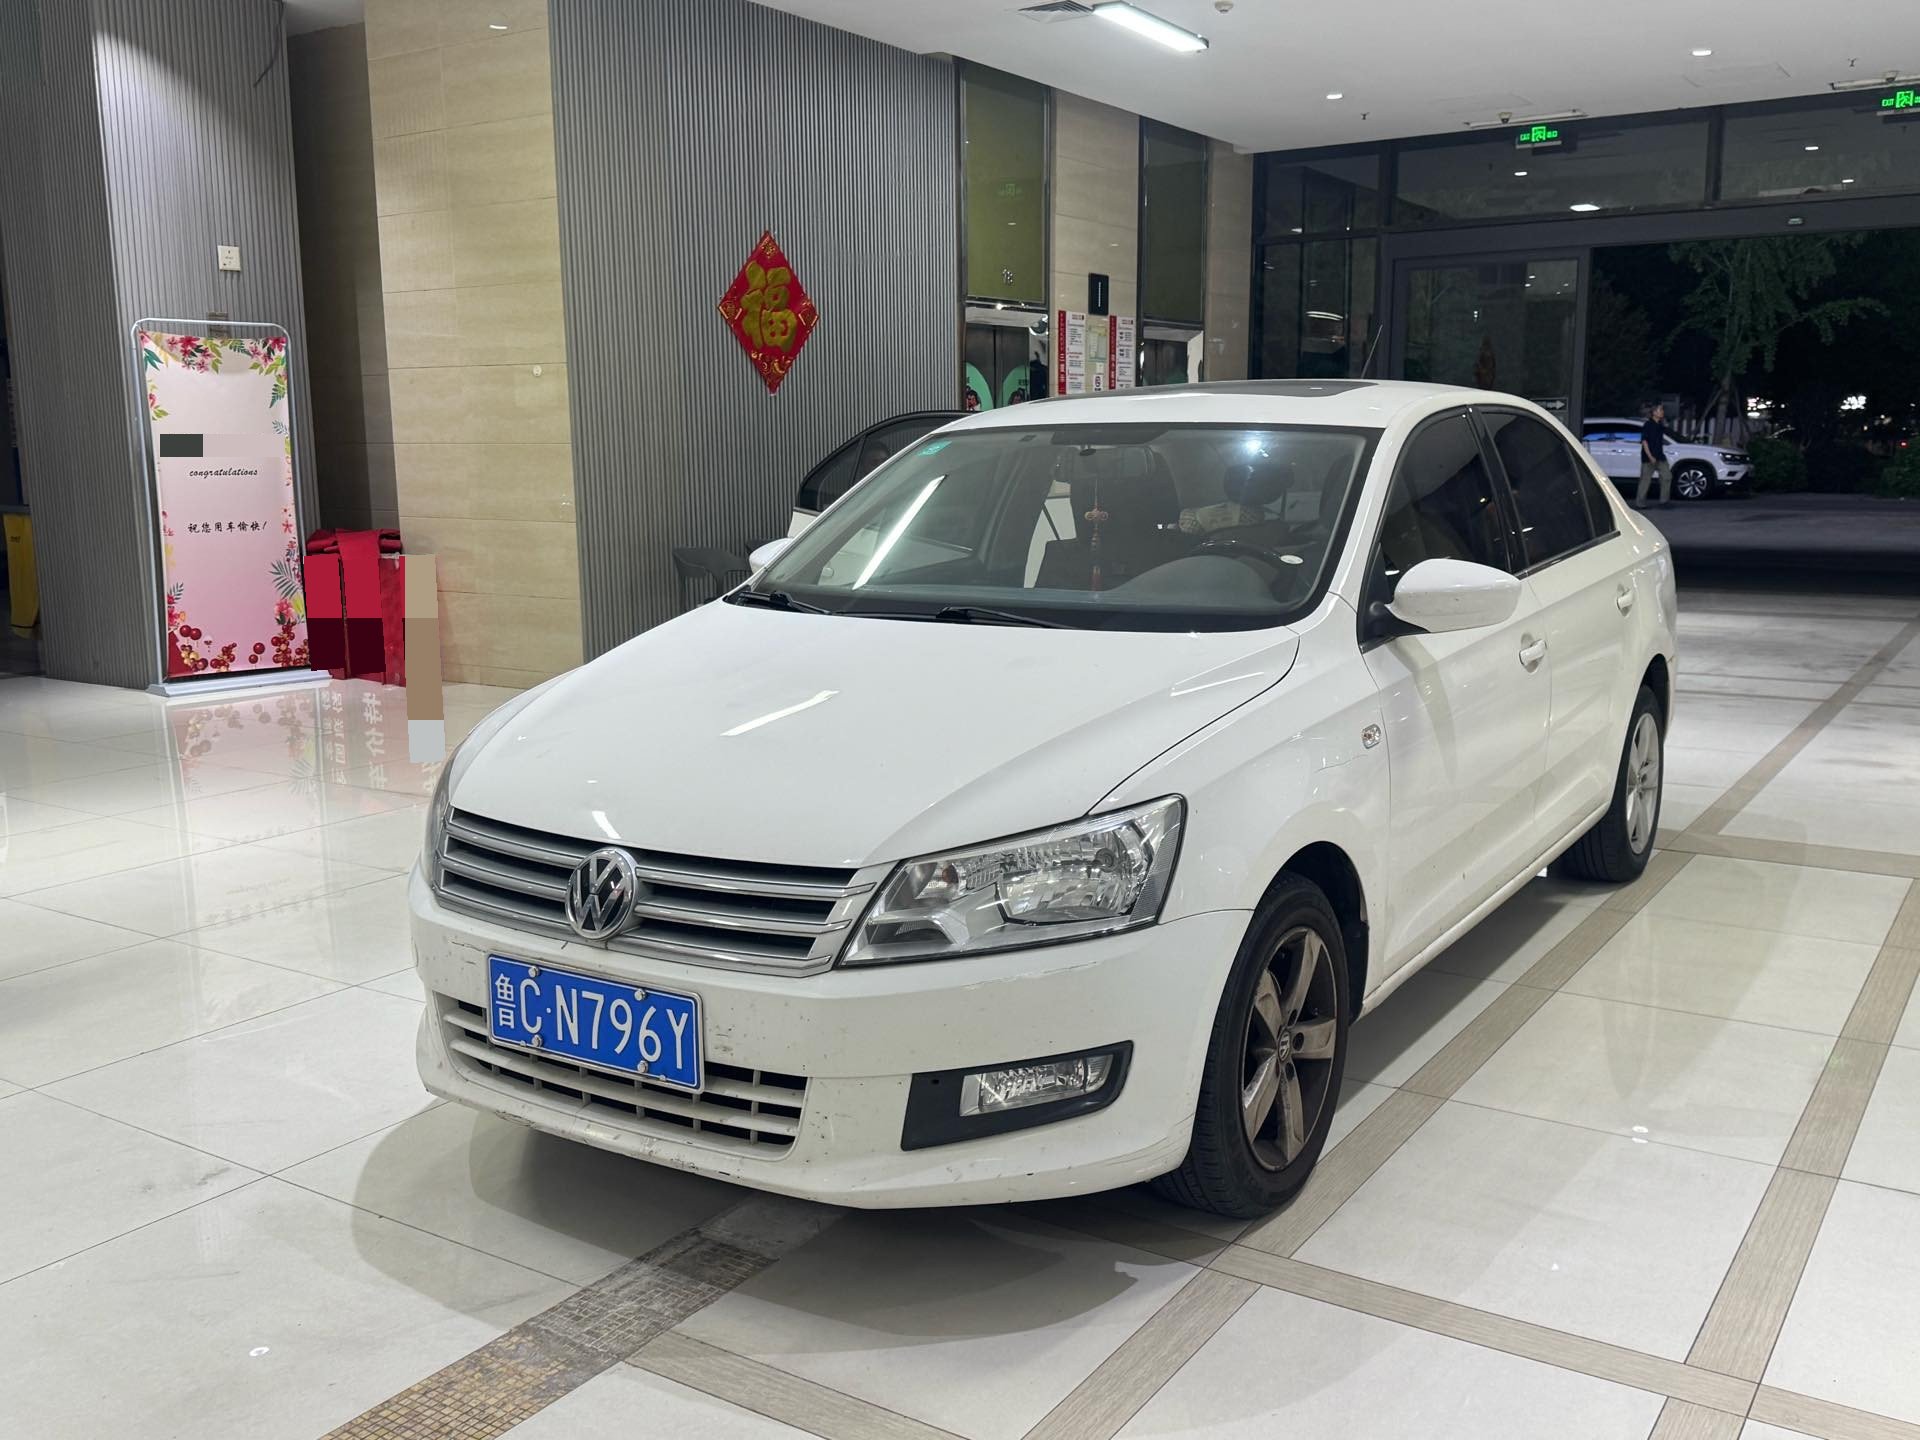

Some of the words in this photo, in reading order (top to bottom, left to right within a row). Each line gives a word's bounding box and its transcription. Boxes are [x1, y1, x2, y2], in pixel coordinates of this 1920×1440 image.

[741, 260, 798, 352] 福
[189, 467, 259, 479] congratulations
[494, 972, 690, 1071] 鲁C·N796Y
